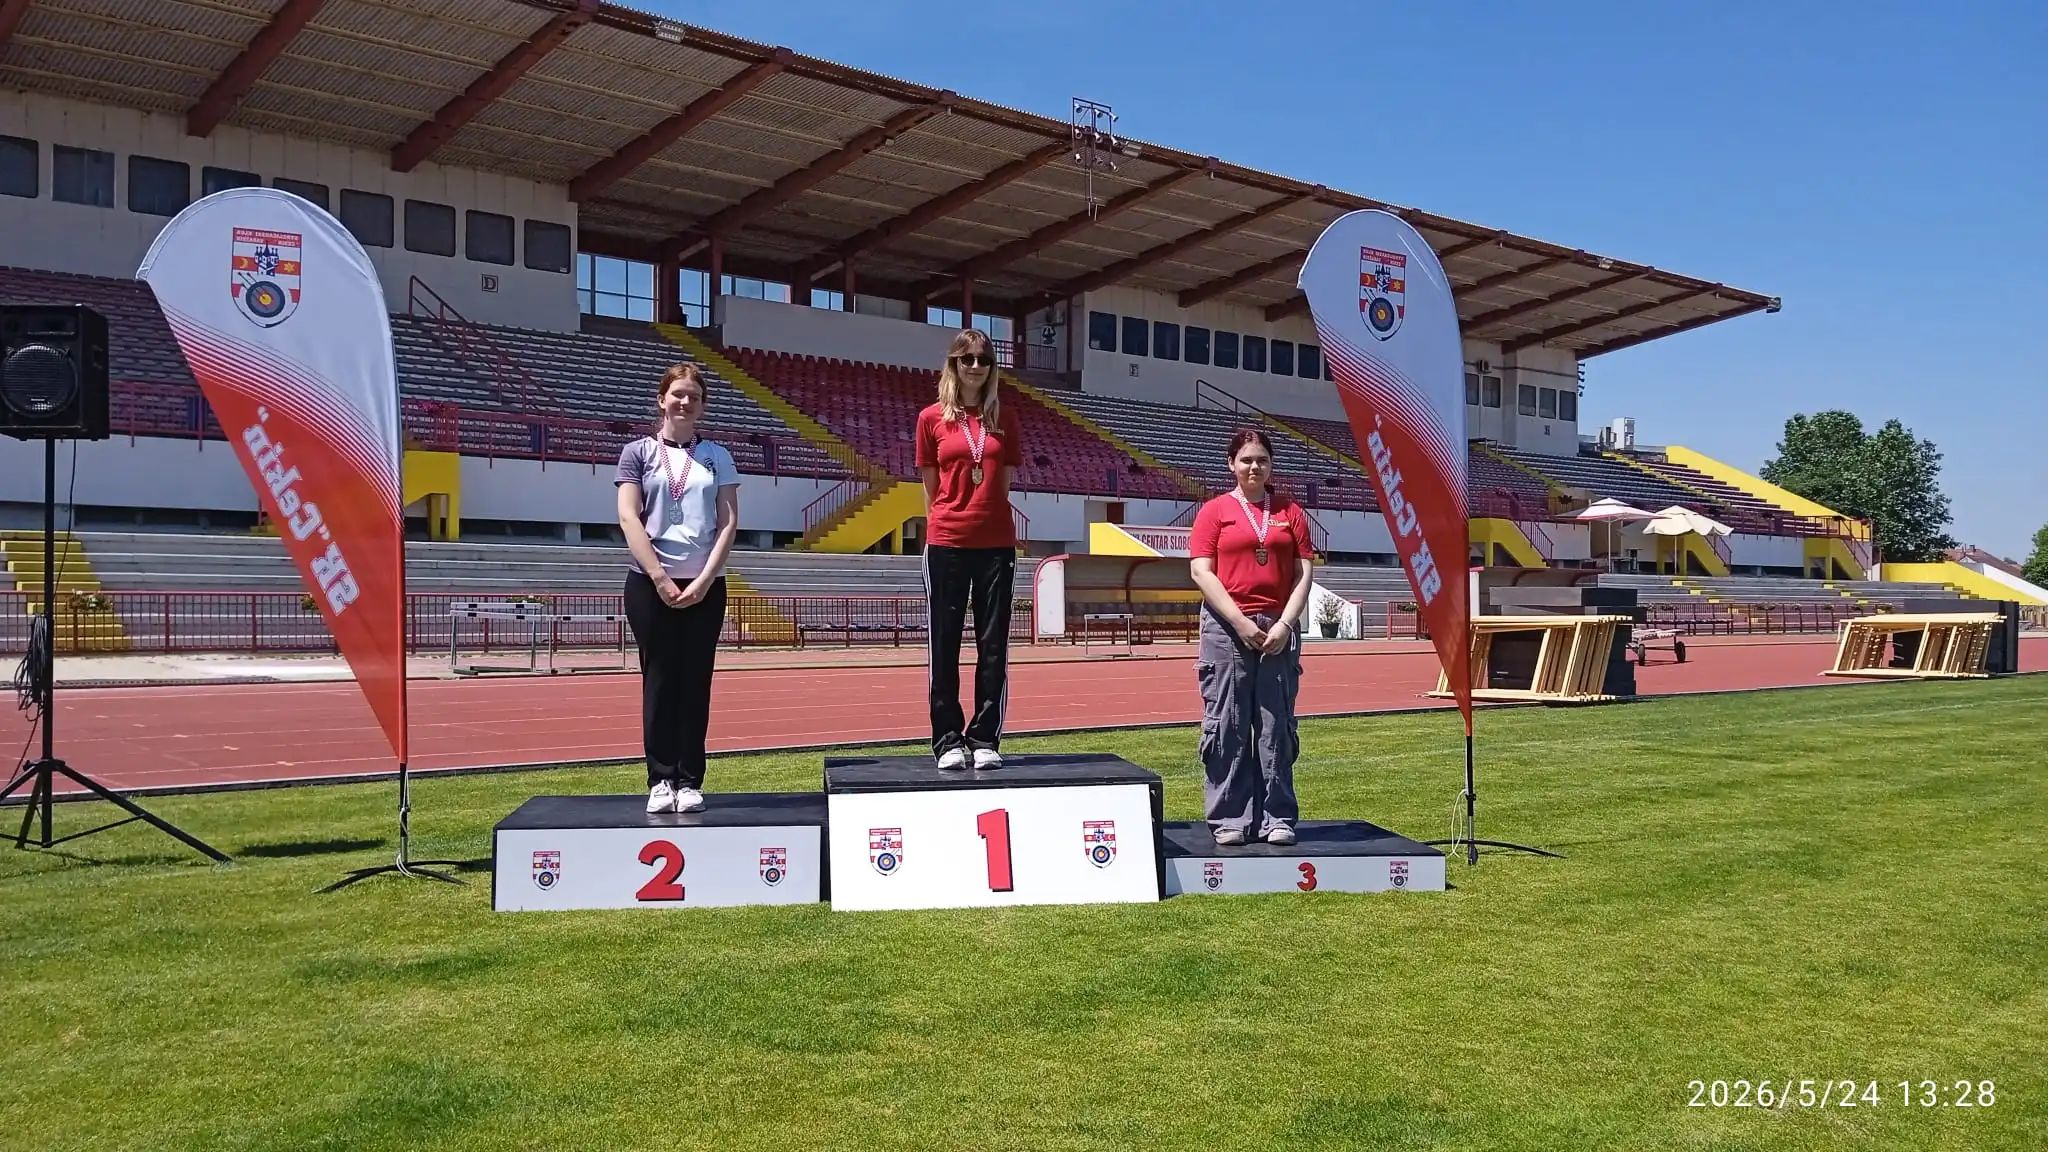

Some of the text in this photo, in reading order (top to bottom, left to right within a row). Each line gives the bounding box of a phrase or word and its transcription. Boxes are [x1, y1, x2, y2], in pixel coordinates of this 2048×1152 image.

[484, 276, 496, 290] D
[1141, 534, 1168, 550] CENTAR
[977, 808, 1014, 892] 1
[635, 839, 685, 902] 2
[1296, 861, 1318, 892] 3
